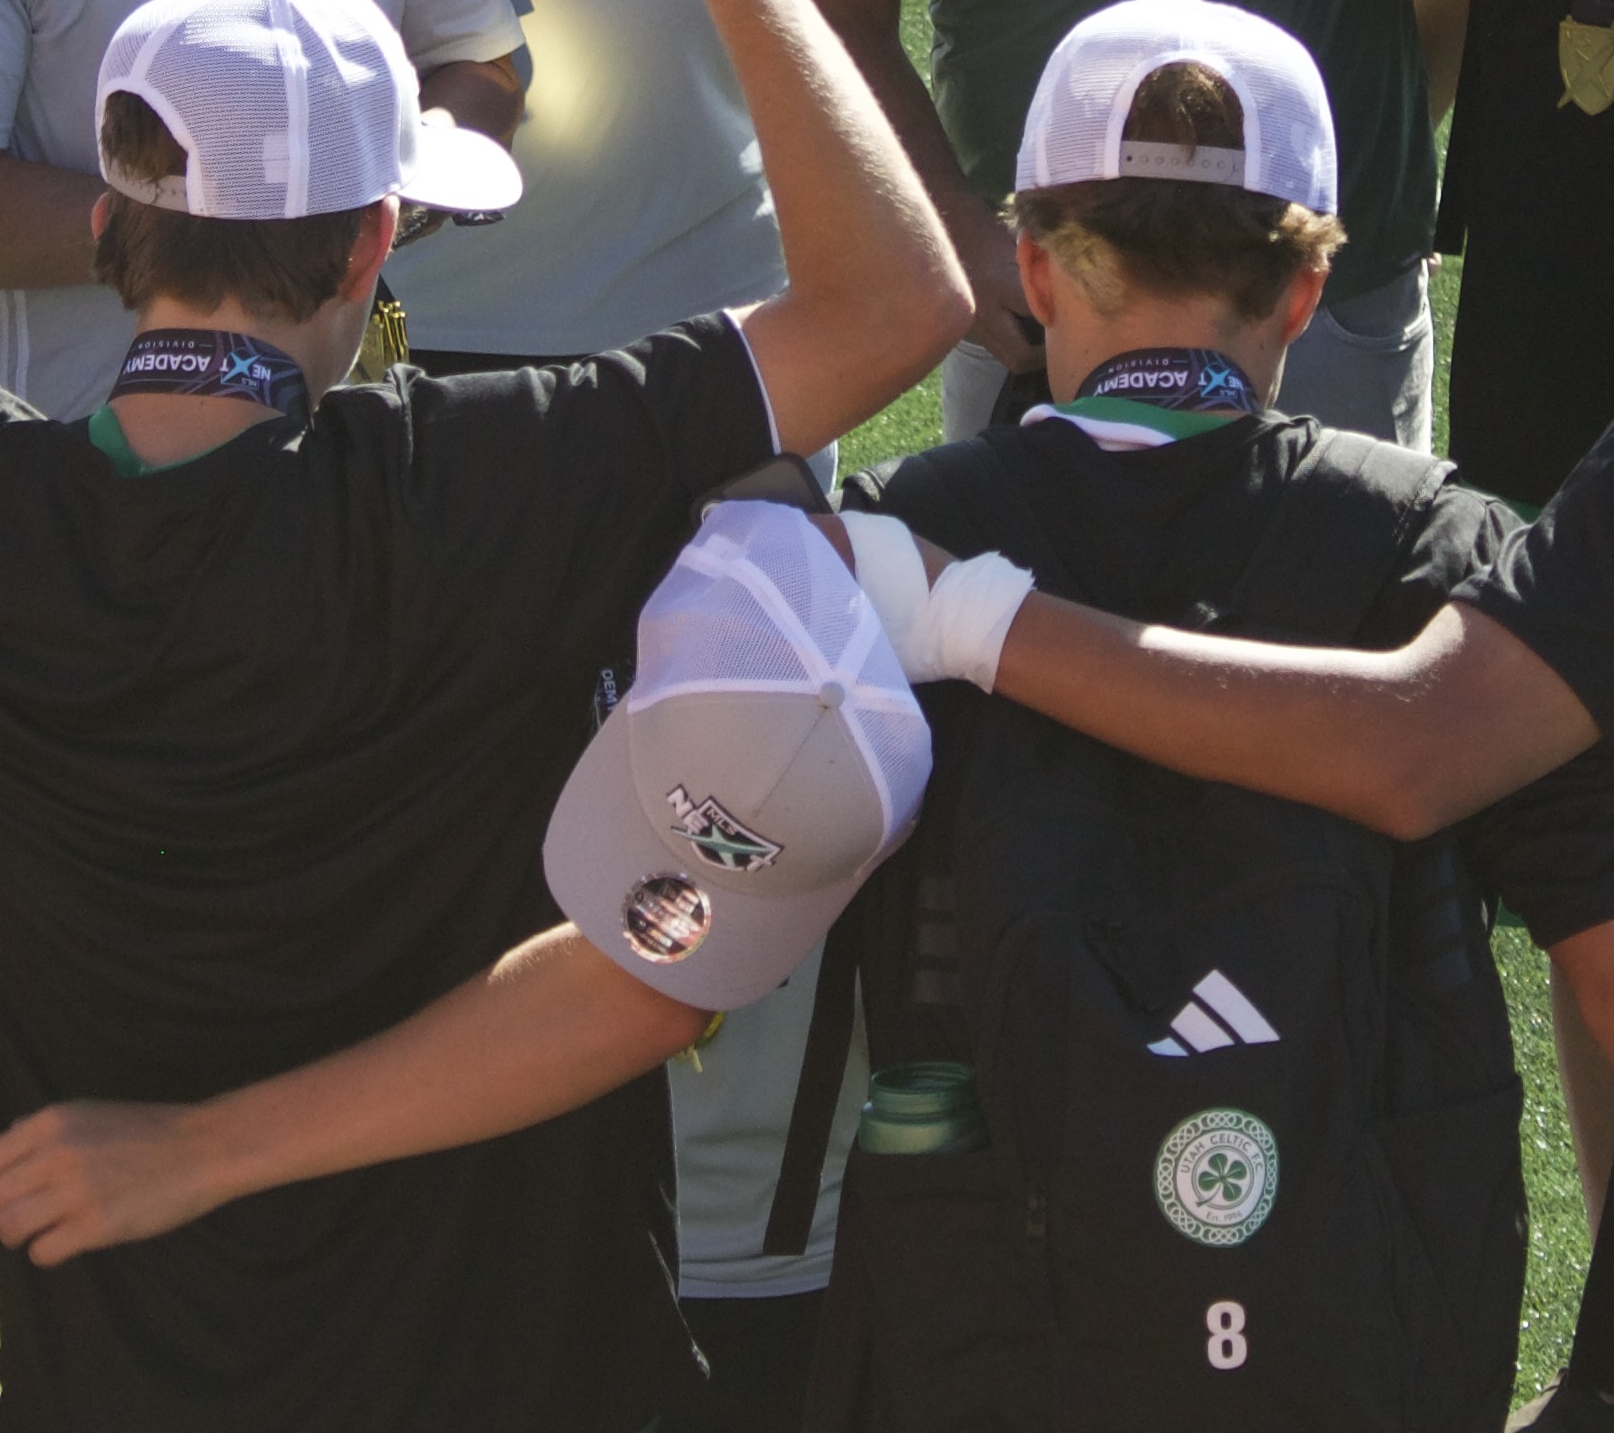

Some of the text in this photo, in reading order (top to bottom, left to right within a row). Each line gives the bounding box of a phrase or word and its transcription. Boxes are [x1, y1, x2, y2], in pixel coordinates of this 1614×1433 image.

[219, 351, 272, 383] NEXT
[1093, 370, 1189, 397] ACADEMY
[706, 806, 740, 837] MLS
[1179, 1142, 1206, 1174] UTAH
[1208, 1133, 1253, 1153] CELTIC
[1205, 1301, 1248, 1370] 8
